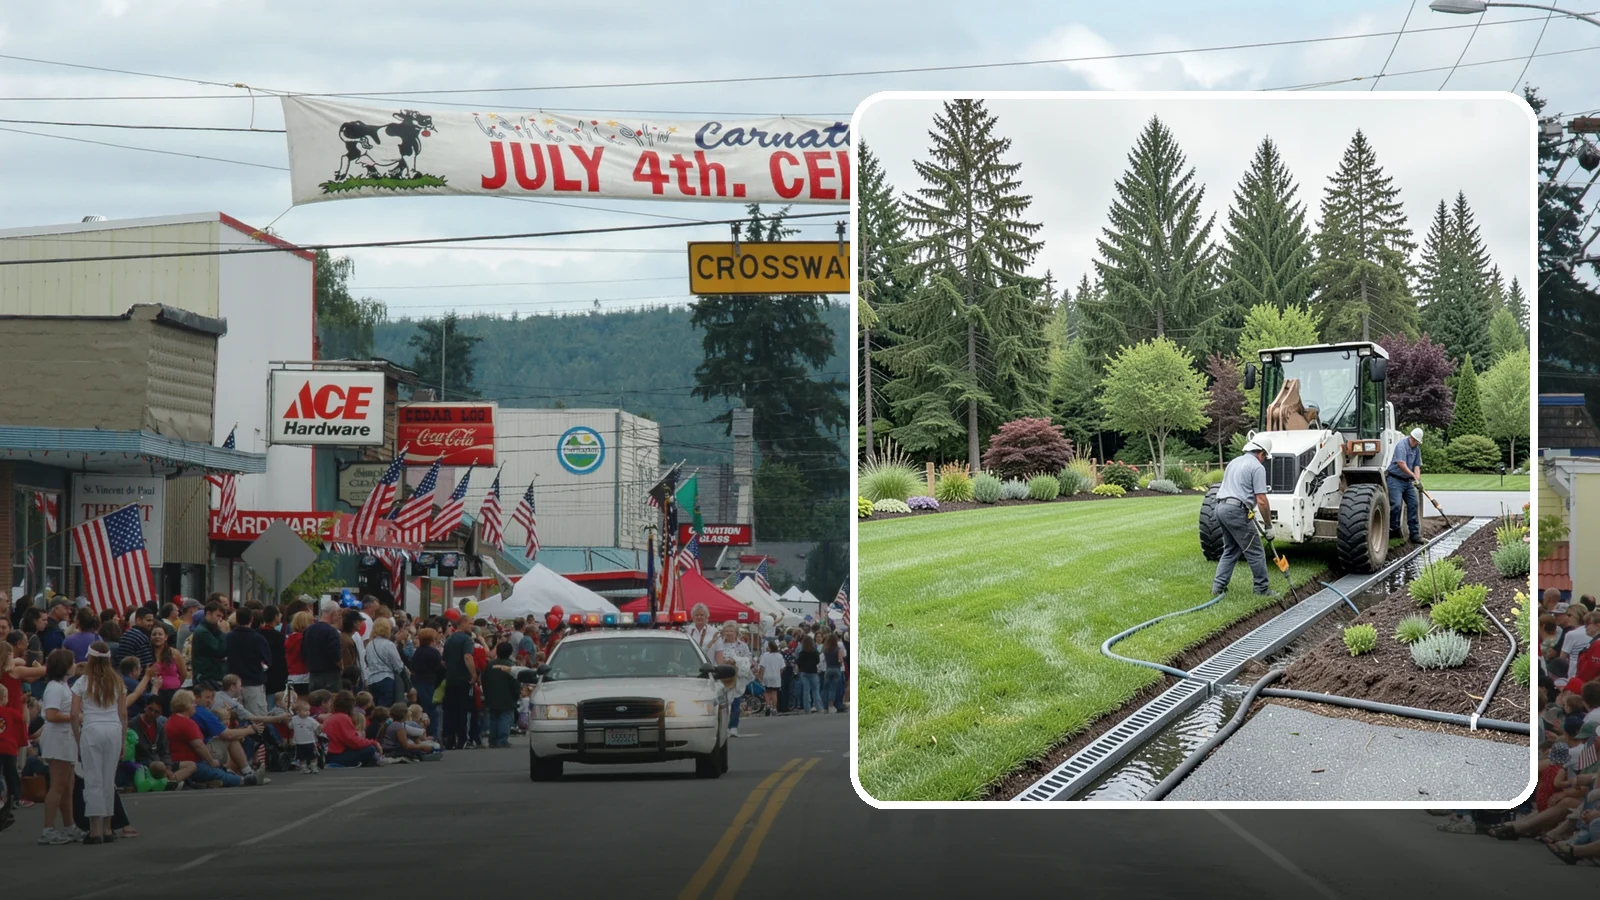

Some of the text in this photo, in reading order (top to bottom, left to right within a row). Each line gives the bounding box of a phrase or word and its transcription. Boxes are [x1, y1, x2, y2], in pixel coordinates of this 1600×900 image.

[695, 121, 850, 150] Carnat
[481, 141, 604, 192] JULY
[632, 150, 746, 198] 4th.
[696, 254, 850, 280] CROSSWA
[282, 380, 374, 420] ACE
[405, 408, 453, 422] CEDAR
[283, 421, 371, 437] Hardware
[416, 428, 476, 447] Coca-Cola
[353, 467, 387, 480] Simpl
[83, 485, 155, 495] St. Vincent de Paul
[688, 526, 741, 535] CRNATION
[699, 535, 730, 543] GLASS
